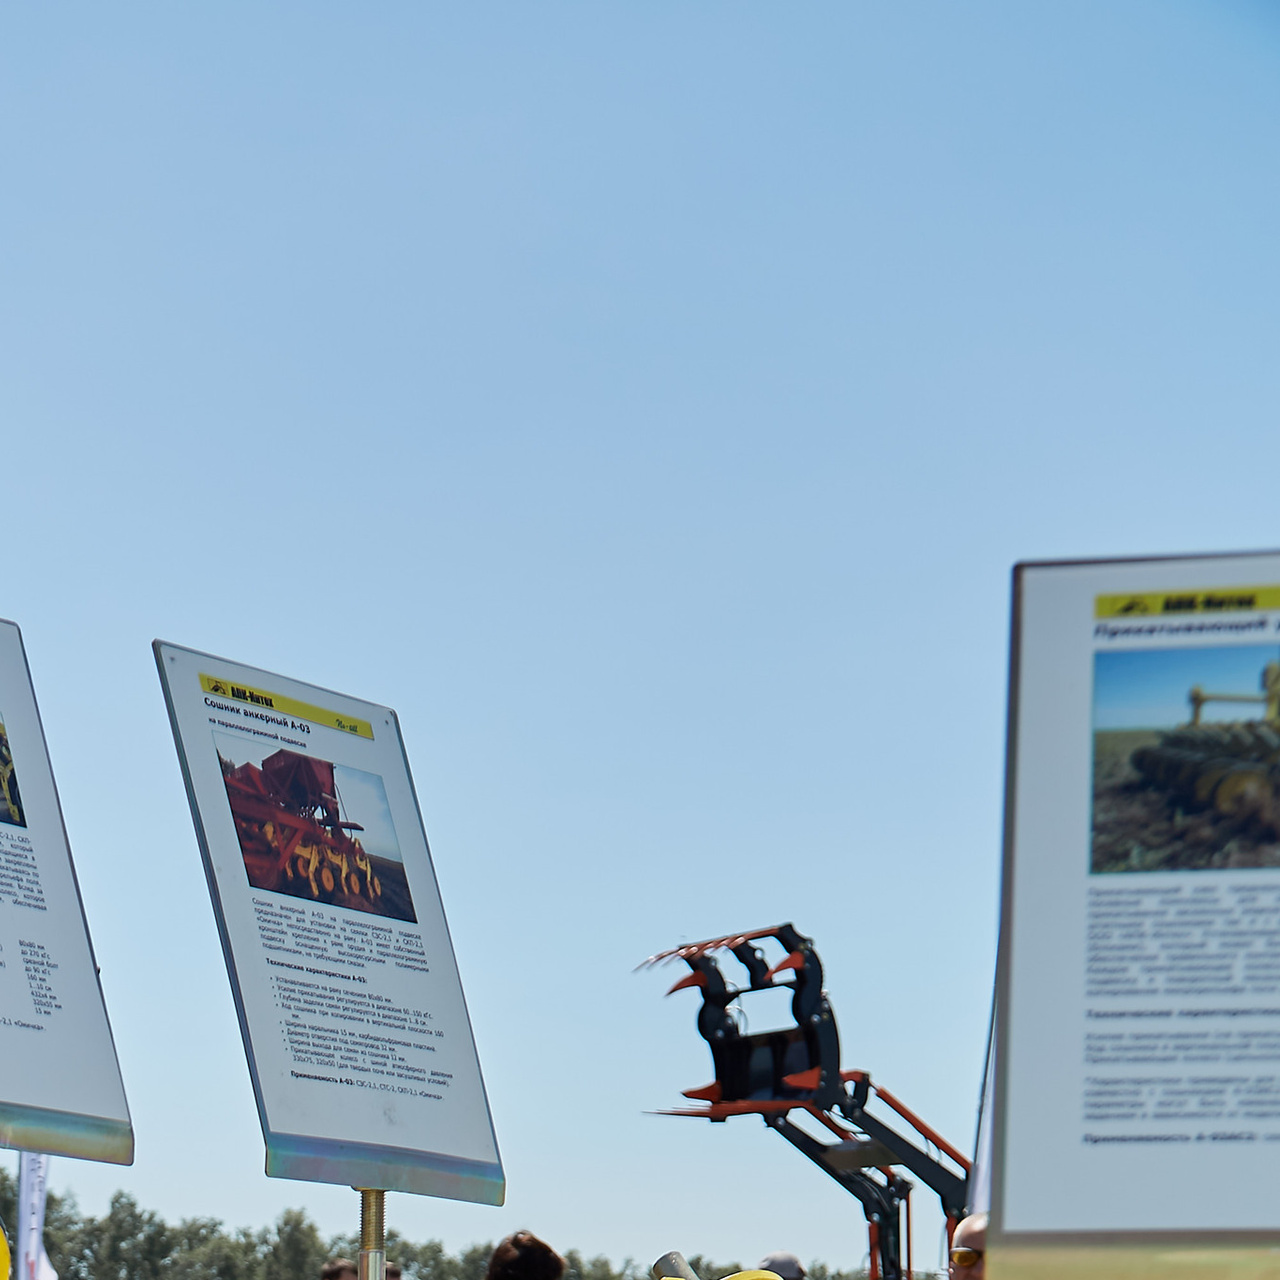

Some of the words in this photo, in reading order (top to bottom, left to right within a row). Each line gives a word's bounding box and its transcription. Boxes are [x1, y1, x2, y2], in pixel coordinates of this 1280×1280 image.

[204, 697, 241, 714] Сошник
[243, 709, 288, 727] анкерный
[291, 720, 310, 734] А-03
